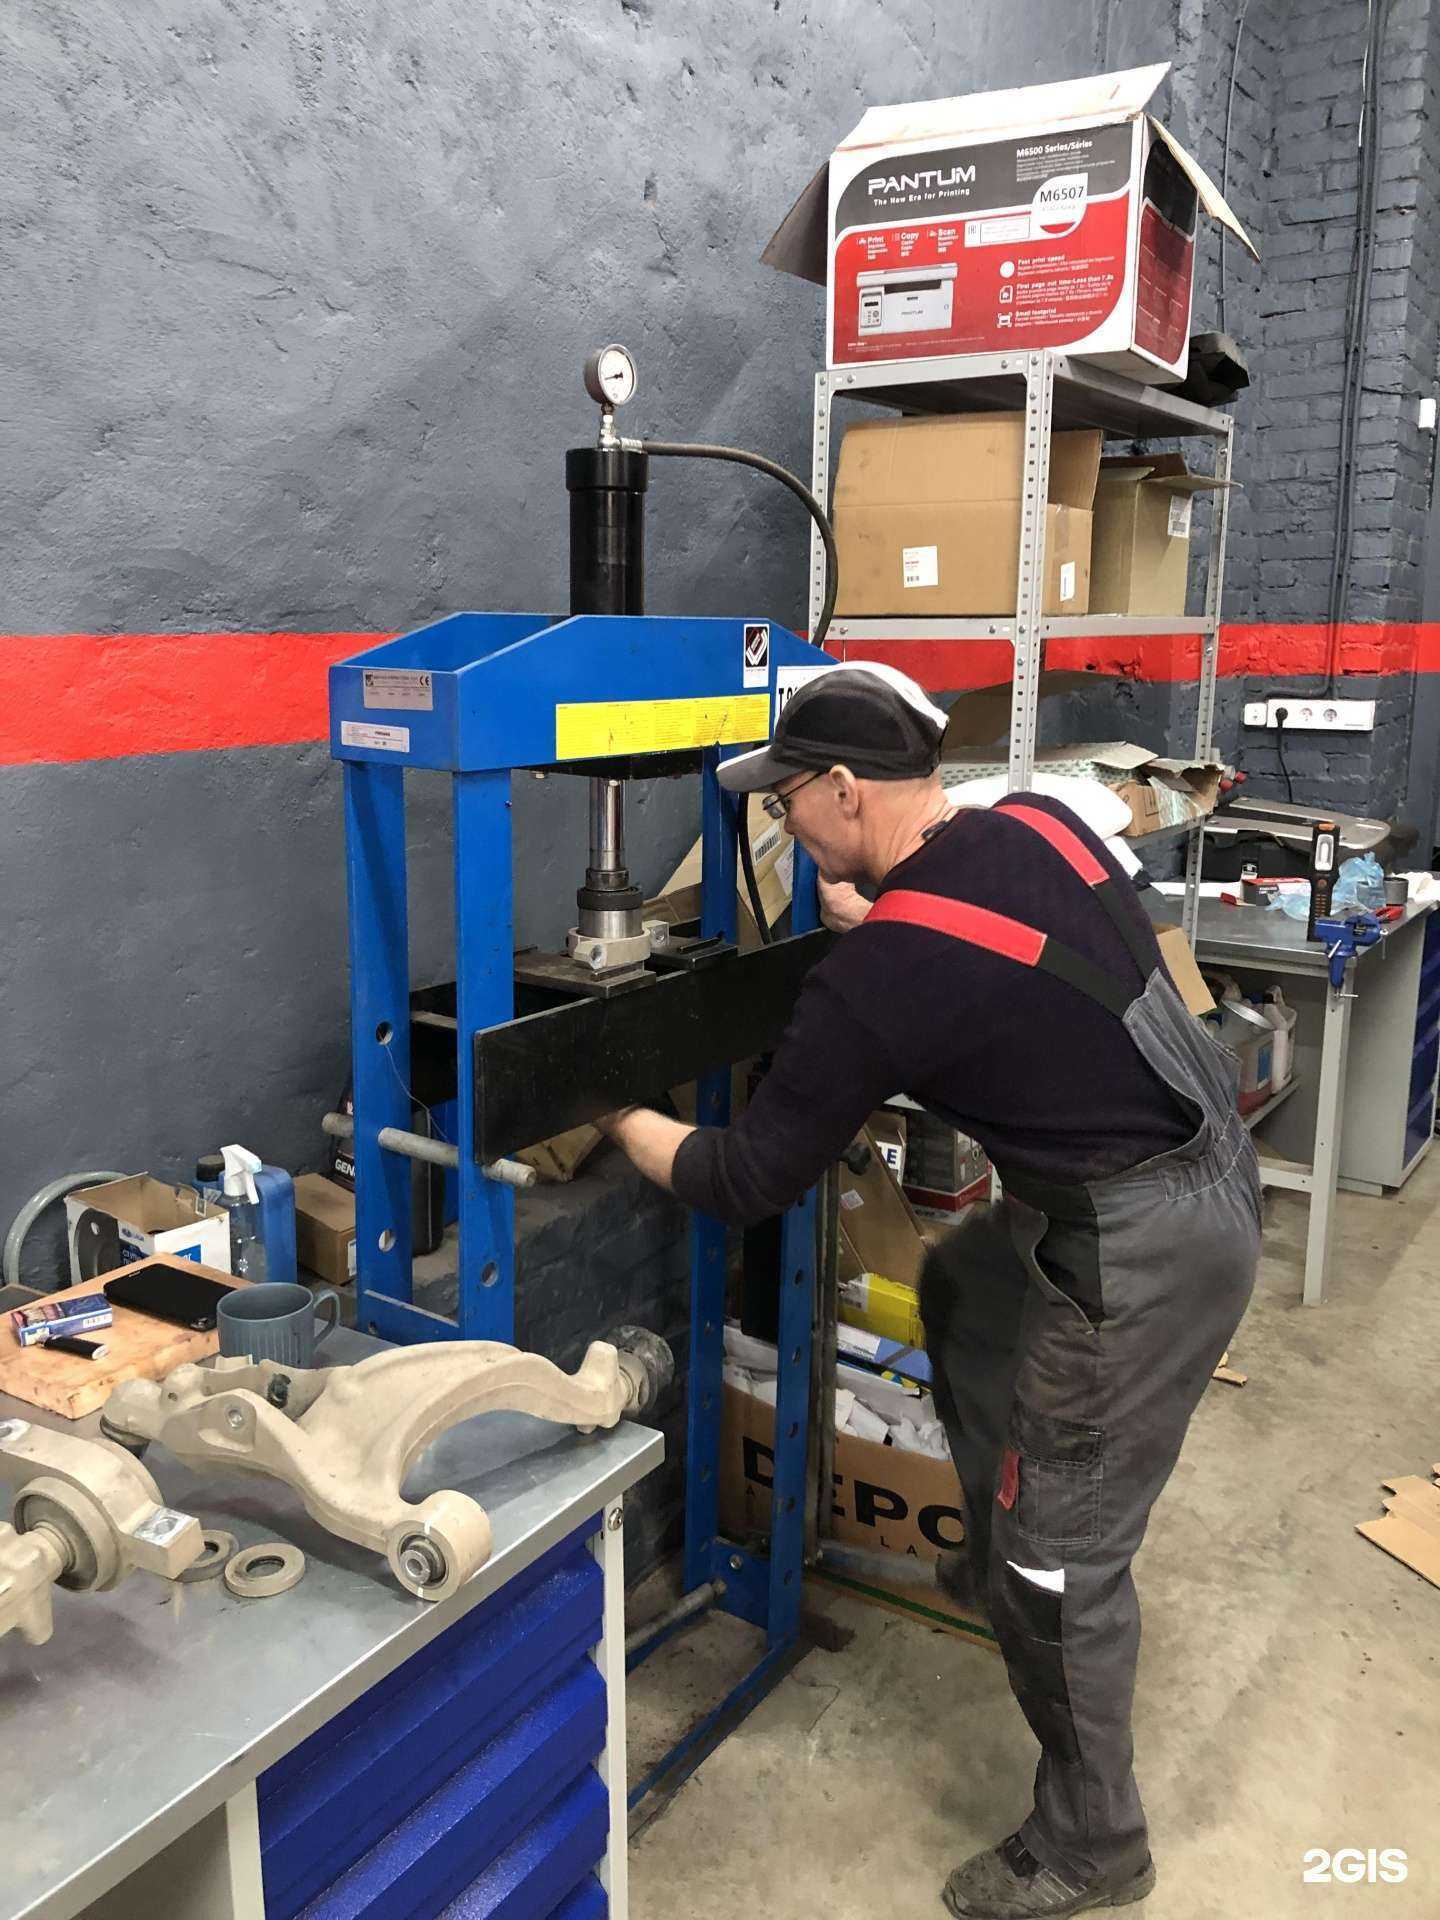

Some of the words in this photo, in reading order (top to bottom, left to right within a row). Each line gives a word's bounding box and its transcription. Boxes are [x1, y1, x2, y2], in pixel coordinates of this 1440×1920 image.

[1016, 146, 1044, 158] M6500
[868, 165, 976, 195] PANTUM
[874, 198, 887, 206] The
[909, 194, 921, 202] Era
[924, 191, 935, 200] for
[939, 188, 970, 198] Printing
[1040, 186, 1084, 203] M6507
[868, 236, 884, 244] Print
[901, 232, 919, 241] Copy
[335, 1159, 355, 1177] GEN
